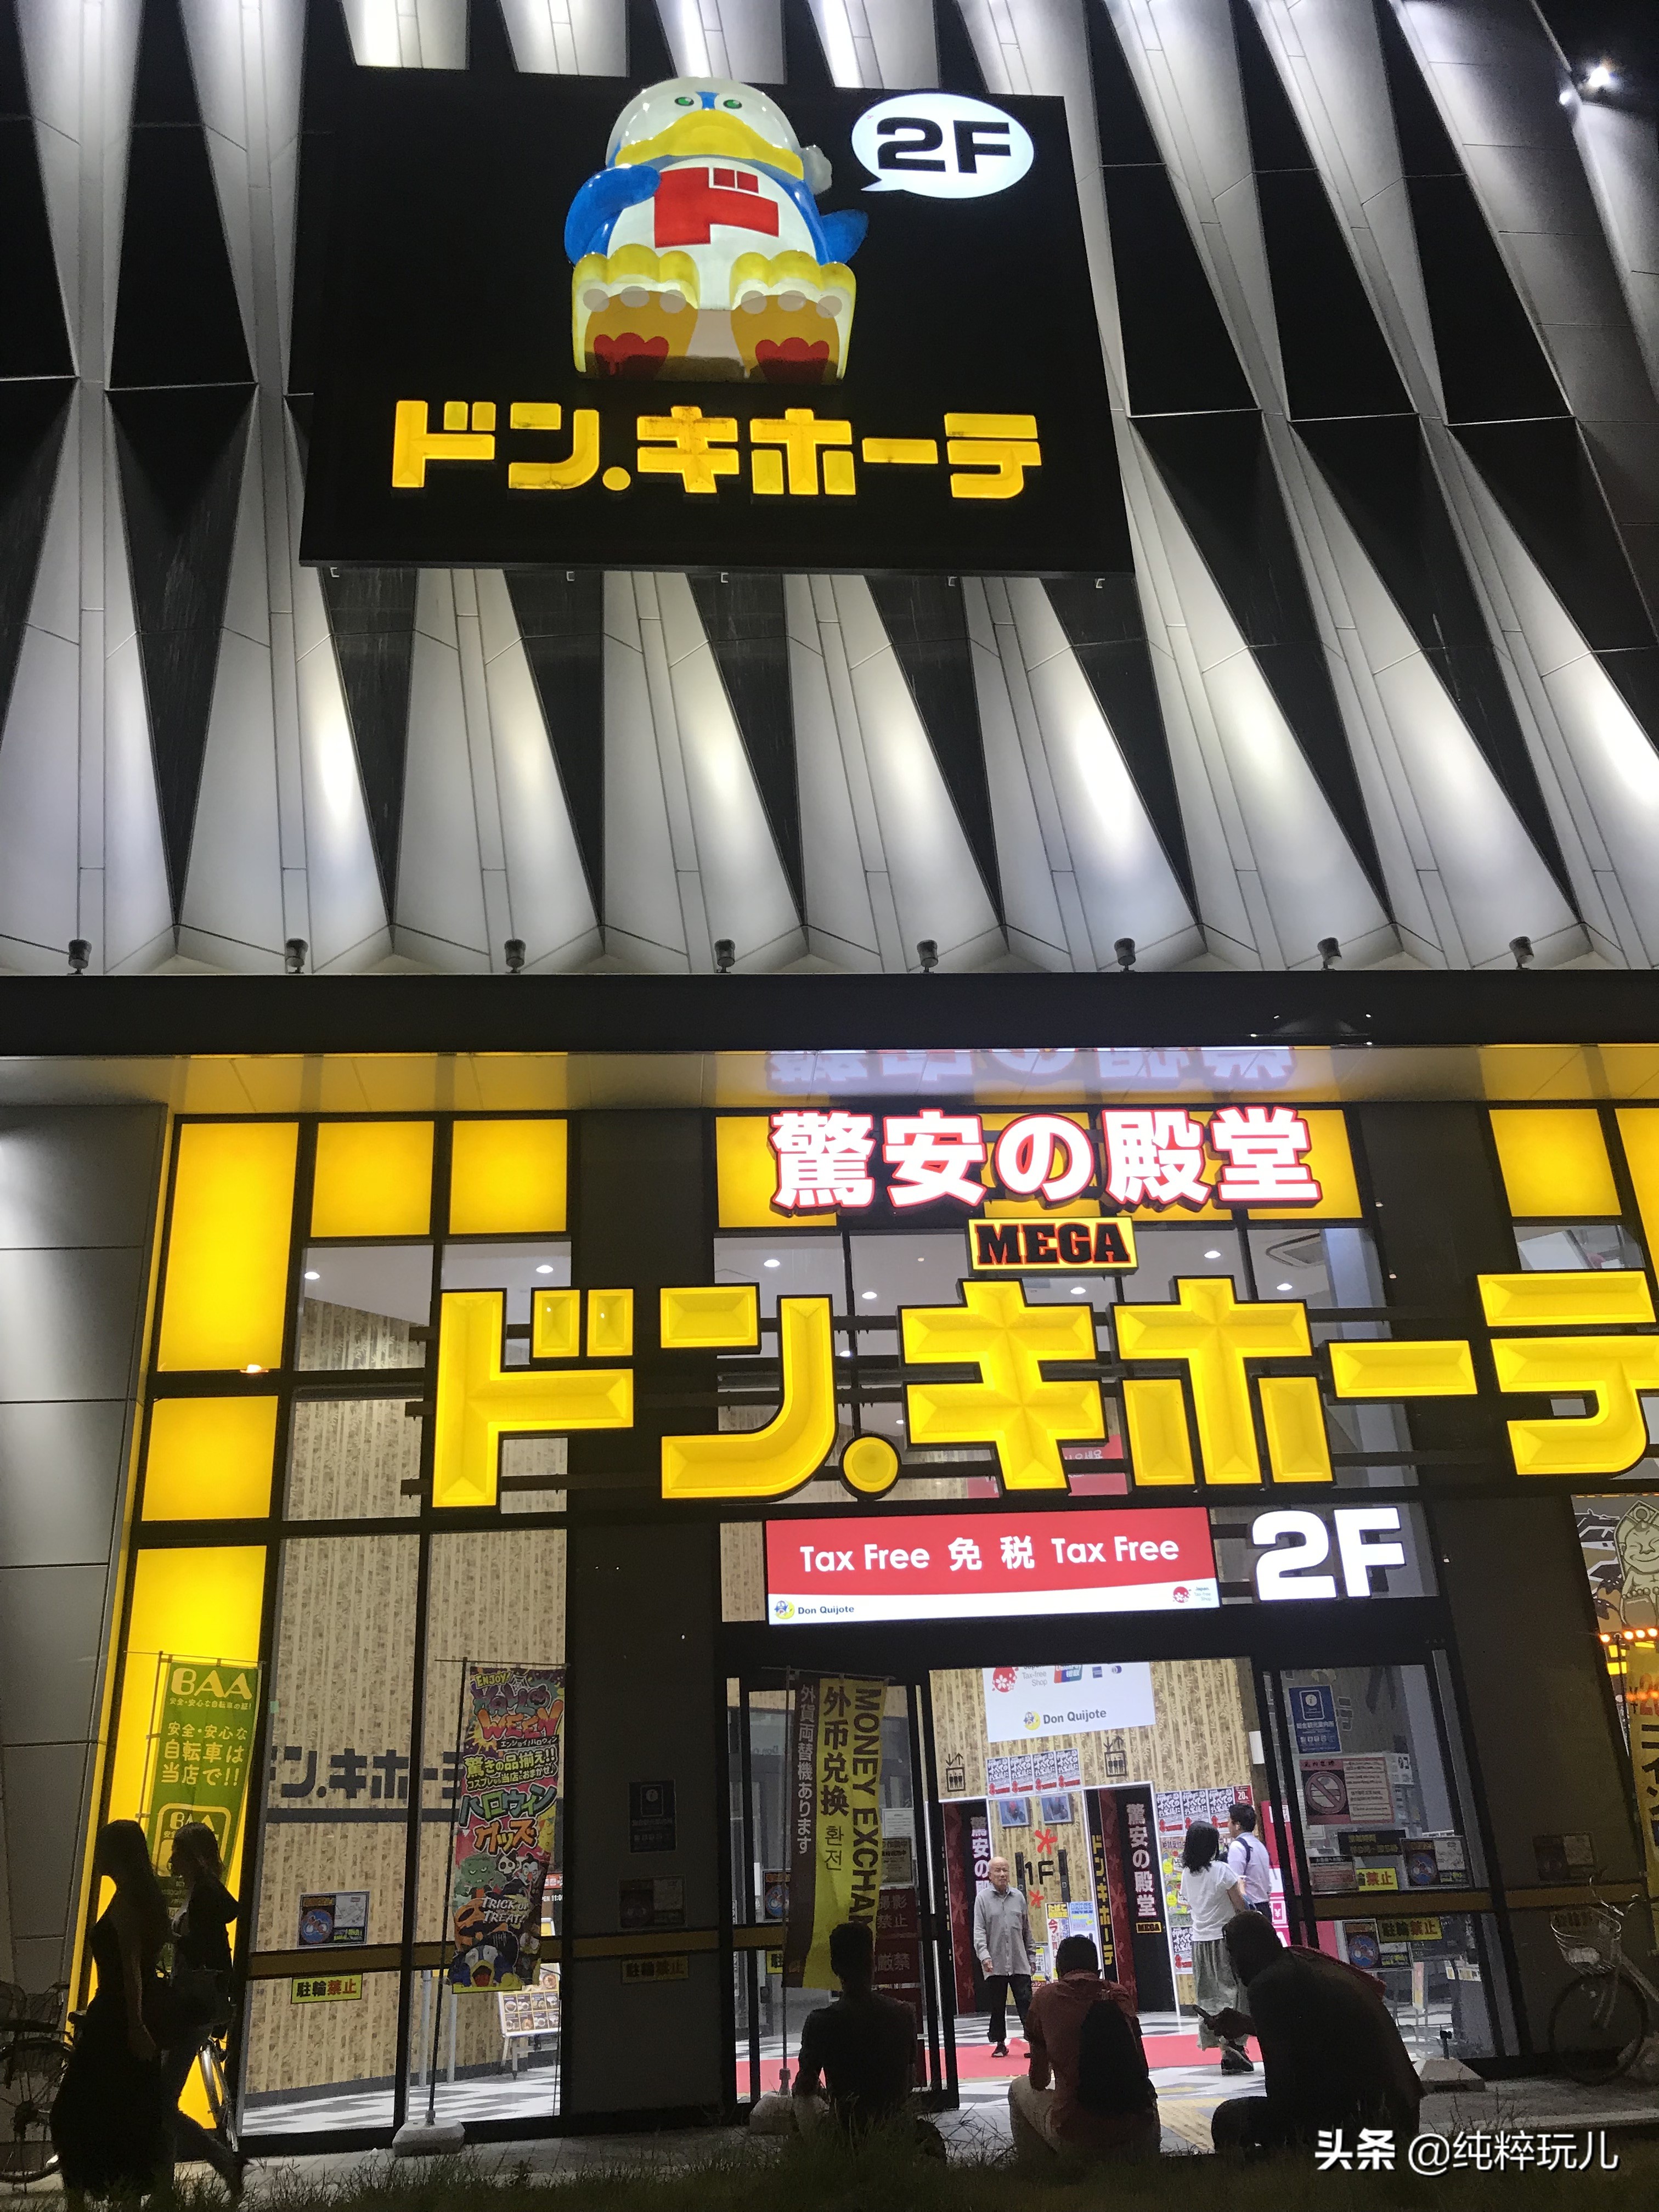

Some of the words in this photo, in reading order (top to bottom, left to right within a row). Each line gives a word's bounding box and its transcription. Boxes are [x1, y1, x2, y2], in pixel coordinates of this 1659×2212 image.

[878, 116, 1011, 173] 2F
[769, 1106, 1322, 1210] 驚安の殿堂
[977, 1222, 1132, 1265] MEGA
[800, 1546, 855, 1572] Tax
[864, 1544, 930, 1570] Free
[1051, 1538, 1107, 1564] Tax
[1114, 1536, 1180, 1561] Free
[1251, 1508, 1406, 1601] 2F
[798, 1606, 816, 1615] Don
[820, 1605, 855, 1615] Quijote
[171, 1667, 253, 1700] BAA
[475, 1672, 511, 1688] ENJOY!
[1022, 1670, 1047, 1679] Tax-free
[1031, 1679, 1047, 1687] Shop
[1043, 1714, 1064, 1724] Don
[1067, 1709, 1107, 1723] Quijote
[165, 1739, 245, 1764] 自転車は
[820, 1685, 851, 1817] 外币兑换
[852, 1688, 882, 1796] MONEY
[797, 1684, 816, 1854] 外貨両替機あります
[459, 1784, 557, 1827] ハロウィン
[474, 1818, 538, 1855] グッズ
[823, 1825, 845, 1871] 환전
[1024, 1860, 1054, 1885] 1F
[1126, 1803, 1157, 1917] 驚安の殿堂
[482, 1897, 515, 1909] TRICK
[296, 1978, 357, 1997] 駐輪禁止
